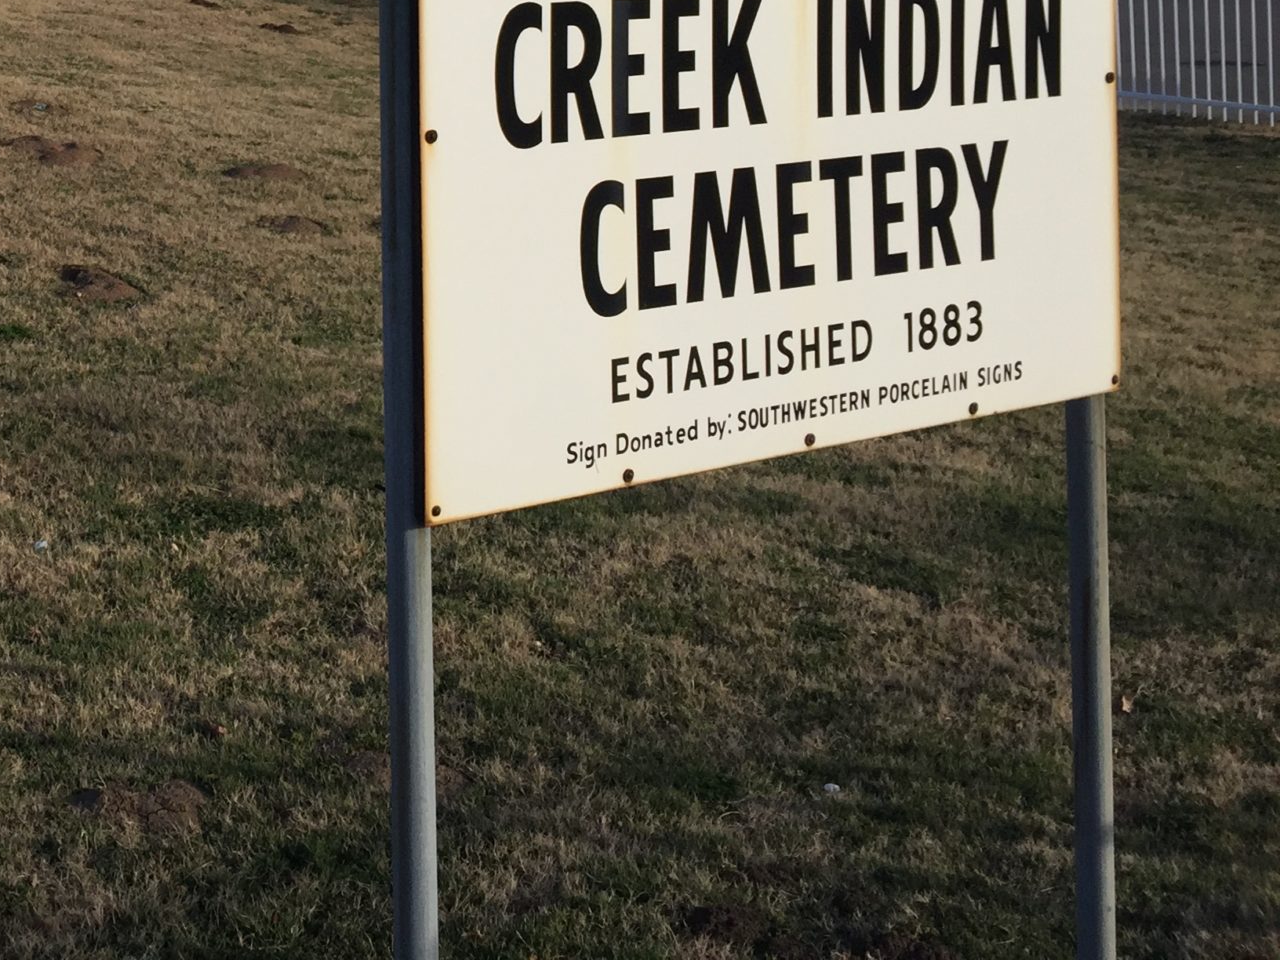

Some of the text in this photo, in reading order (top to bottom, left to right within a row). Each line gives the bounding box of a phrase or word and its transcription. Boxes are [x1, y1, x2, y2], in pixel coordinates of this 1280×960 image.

[579, 139, 1009, 318] CEMETERY
[611, 300, 984, 404] ESTABLISHED 1883
[566, 360, 1024, 469] Sign Donated by: SOUTHWESTERN PORCELAIN SIGNS
